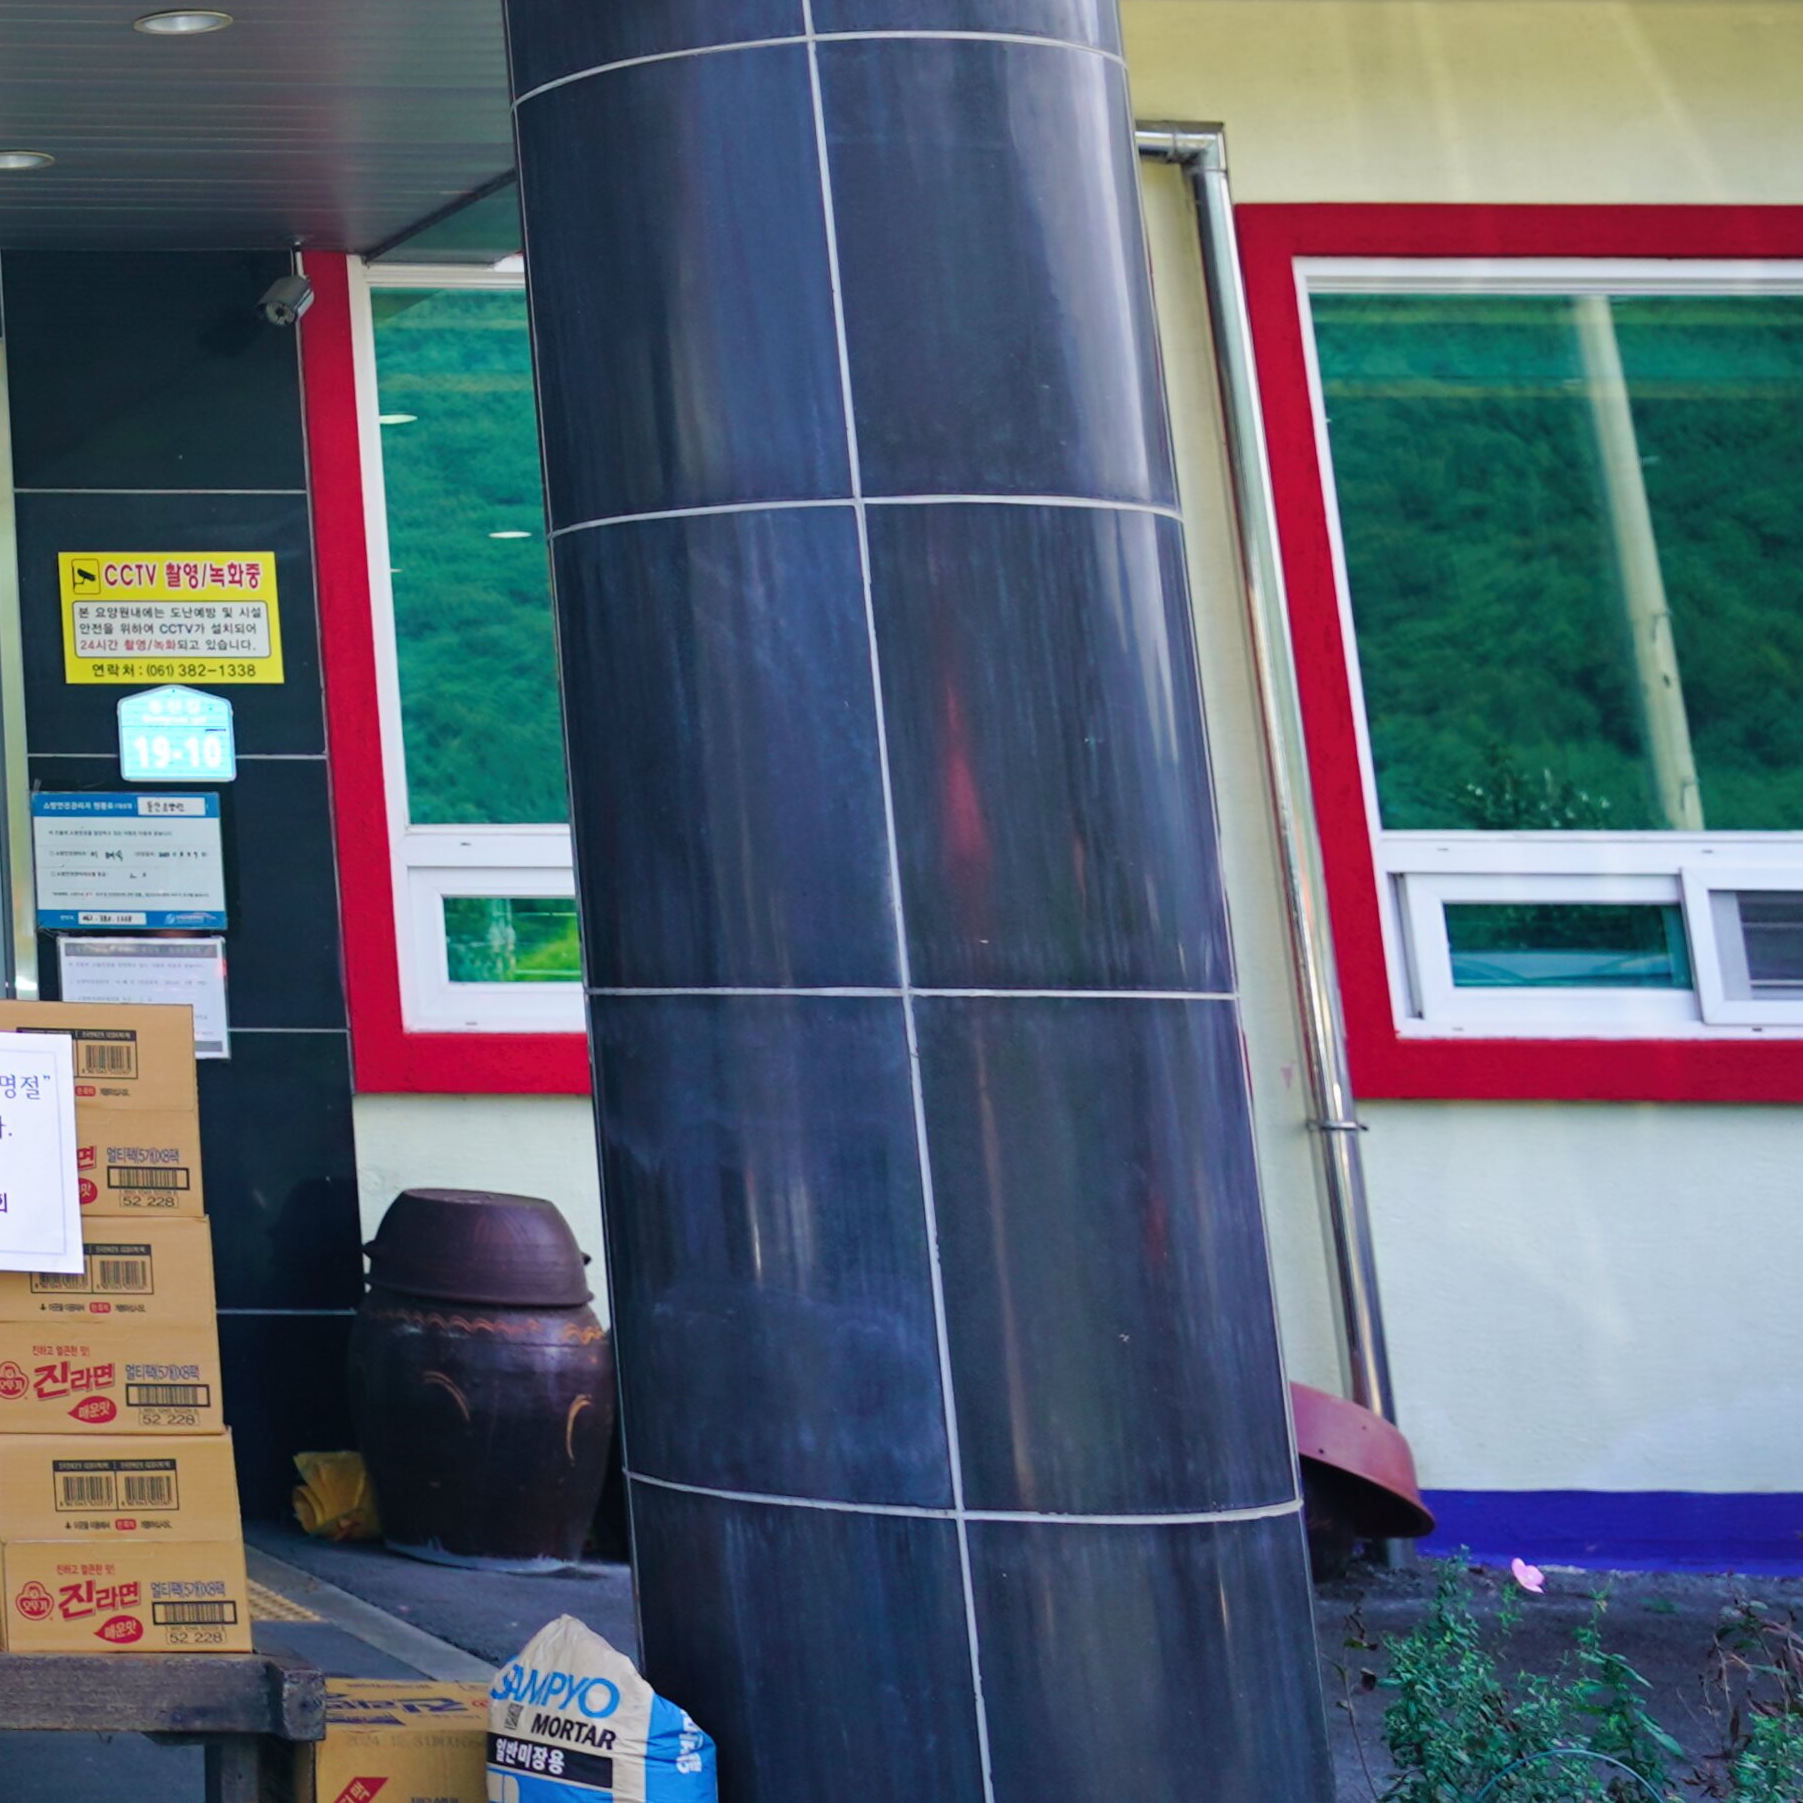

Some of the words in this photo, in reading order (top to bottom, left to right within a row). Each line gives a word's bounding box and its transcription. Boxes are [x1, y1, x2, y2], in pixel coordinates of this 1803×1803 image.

[105, 564, 156, 586] CCTV
[166, 562, 261, 589] 촬영/녹화중
[79, 607, 89, 618] 본
[96, 607, 165, 619] 요양원내에는
[170, 607, 216, 619] 도난예방
[222, 607, 233, 618] 및
[240, 607, 261, 618] 시설
[80, 624, 114, 635] 안전을
[120, 624, 154, 635] 위하여
[159, 624, 205, 635] CCTV가
[211, 624, 257, 635] 설치되어
[80, 640, 118, 651] 24시간
[125, 640, 200, 651] 촬영/녹화되고
[206, 640, 257, 651] 있습니다.
[178, 664, 256, 677] 382-1338
[134, 735, 222, 769] 19-10
[123, 1197, 142, 1207] 52
[147, 1197, 175, 1207] 228
[33, 1361, 115, 1400] 진라면
[78, 1402, 111, 1419] 매운맛
[143, 1415, 161, 1424] 52
[167, 1415, 195, 1424] 228
[59, 1580, 140, 1621] 진라면
[104, 1621, 137, 1638] 매운맛
[170, 1633, 187, 1643] 52
[195, 1633, 223, 1643] 228
[490, 1656, 620, 1719] SAMPYO
[531, 1714, 616, 1750] MORTAR
[496, 1738, 565, 1775] 일반미장용
